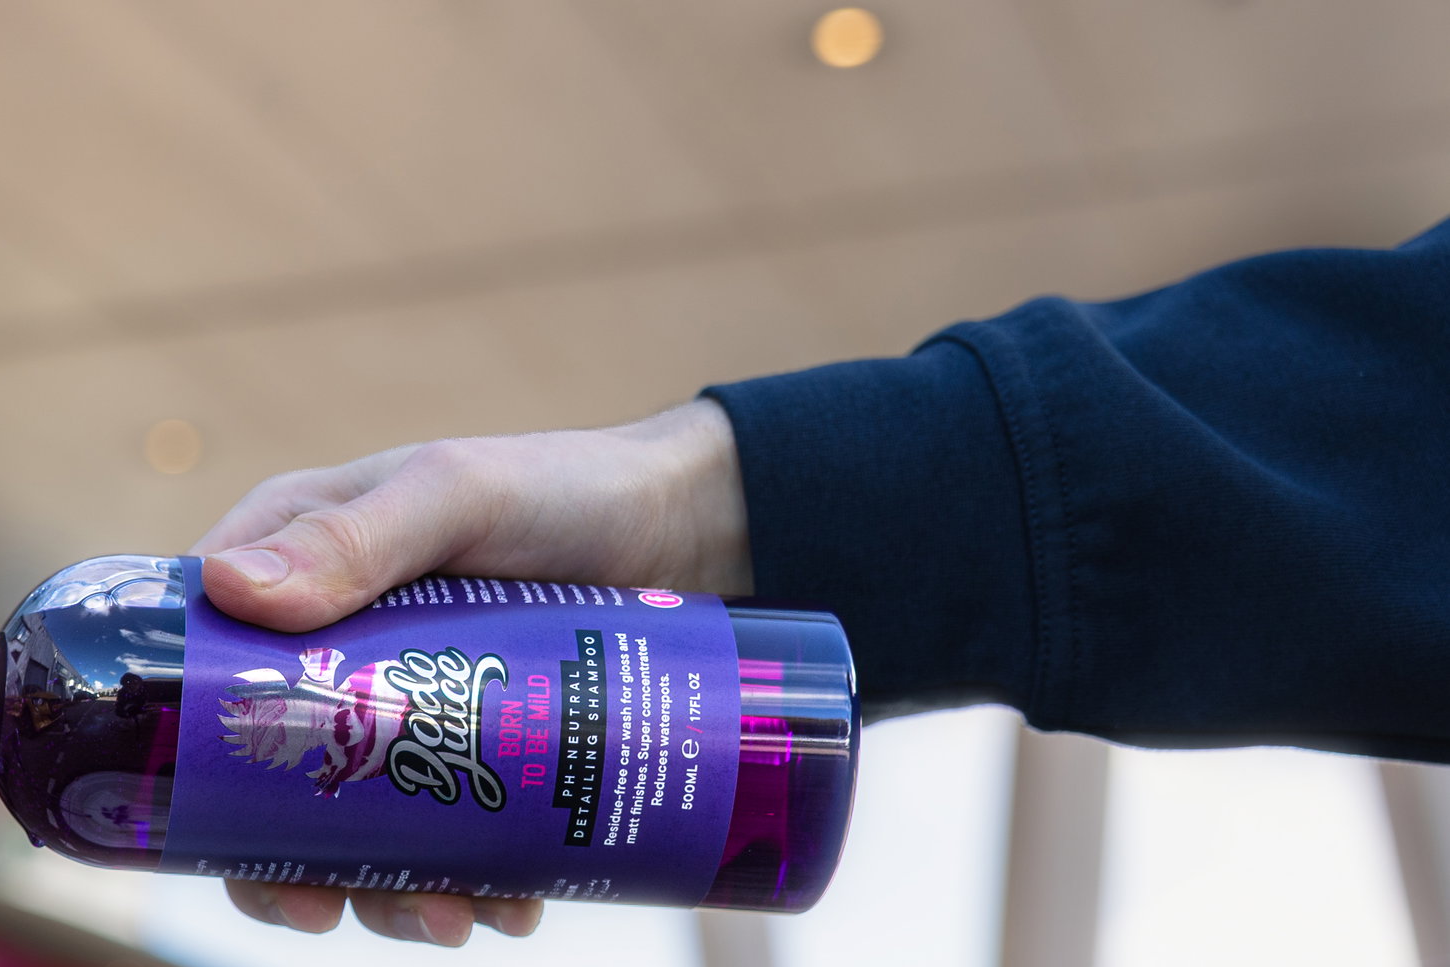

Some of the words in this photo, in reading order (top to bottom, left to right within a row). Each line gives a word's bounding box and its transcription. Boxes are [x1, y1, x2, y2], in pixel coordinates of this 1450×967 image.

[615, 633, 628, 651] and
[584, 636, 599, 721] SHAMPOO
[620, 654, 634, 683] gloss
[635, 637, 651, 717] concentrated.
[688, 672, 700, 690] OZ
[619, 686, 632, 704] for
[658, 673, 673, 747] waterspots.
[688, 693, 701, 722] 17FL
[390, 650, 458, 802] Dodo
[436, 647, 508, 810] Juice
[498, 700, 523, 757] BORN
[526, 729, 549, 754] BE
[563, 670, 580, 797] PH-NEUTRAL
[620, 707, 632, 740] wash
[638, 720, 652, 760] Super
[521, 764, 546, 788] TO
[619, 745, 630, 765] car
[574, 735, 598, 838] DETAILING
[631, 763, 648, 815] finishes.
[651, 750, 668, 806] Reduces
[682, 765, 698, 810] 500ML
[604, 769, 628, 845] Residue-free
[626, 818, 640, 844] matt
